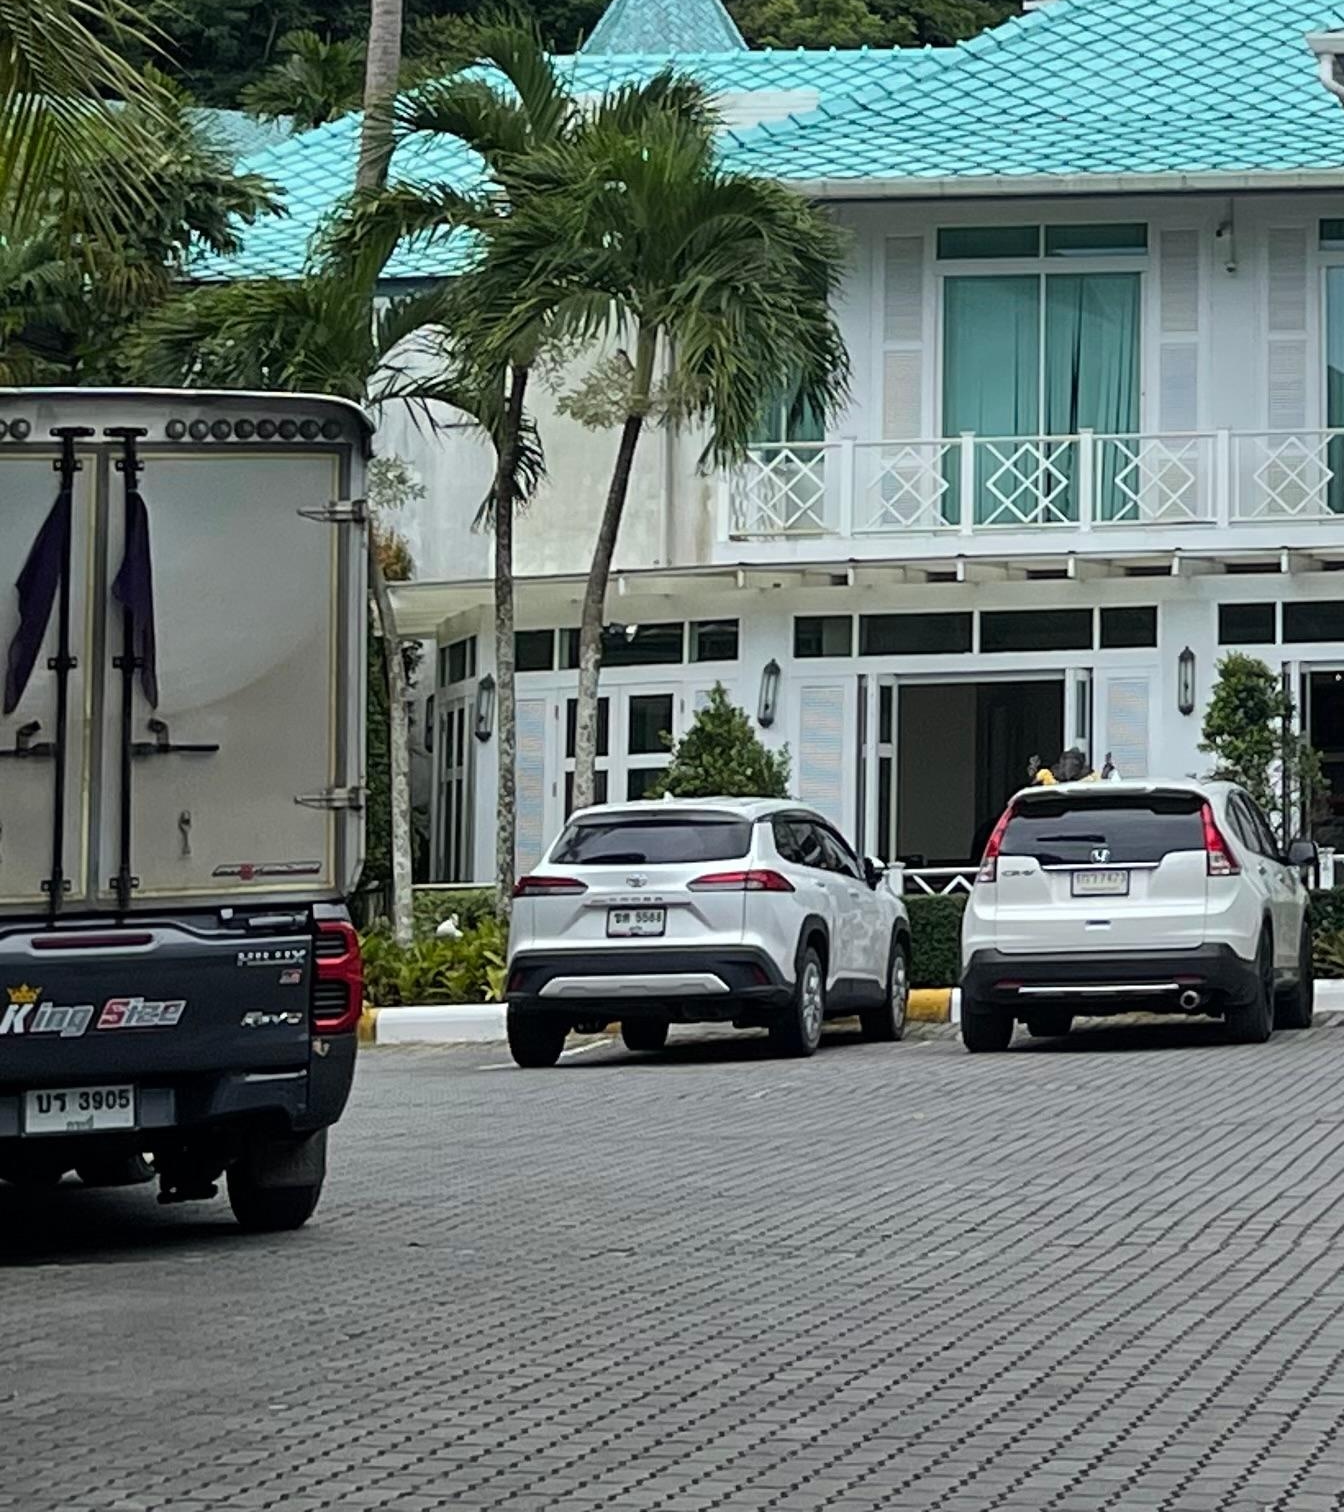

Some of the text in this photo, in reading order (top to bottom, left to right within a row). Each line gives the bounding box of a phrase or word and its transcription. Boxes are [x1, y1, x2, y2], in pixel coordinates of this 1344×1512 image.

[0, 996, 187, 1038] King Size
[78, 1089, 131, 1111] 3905
